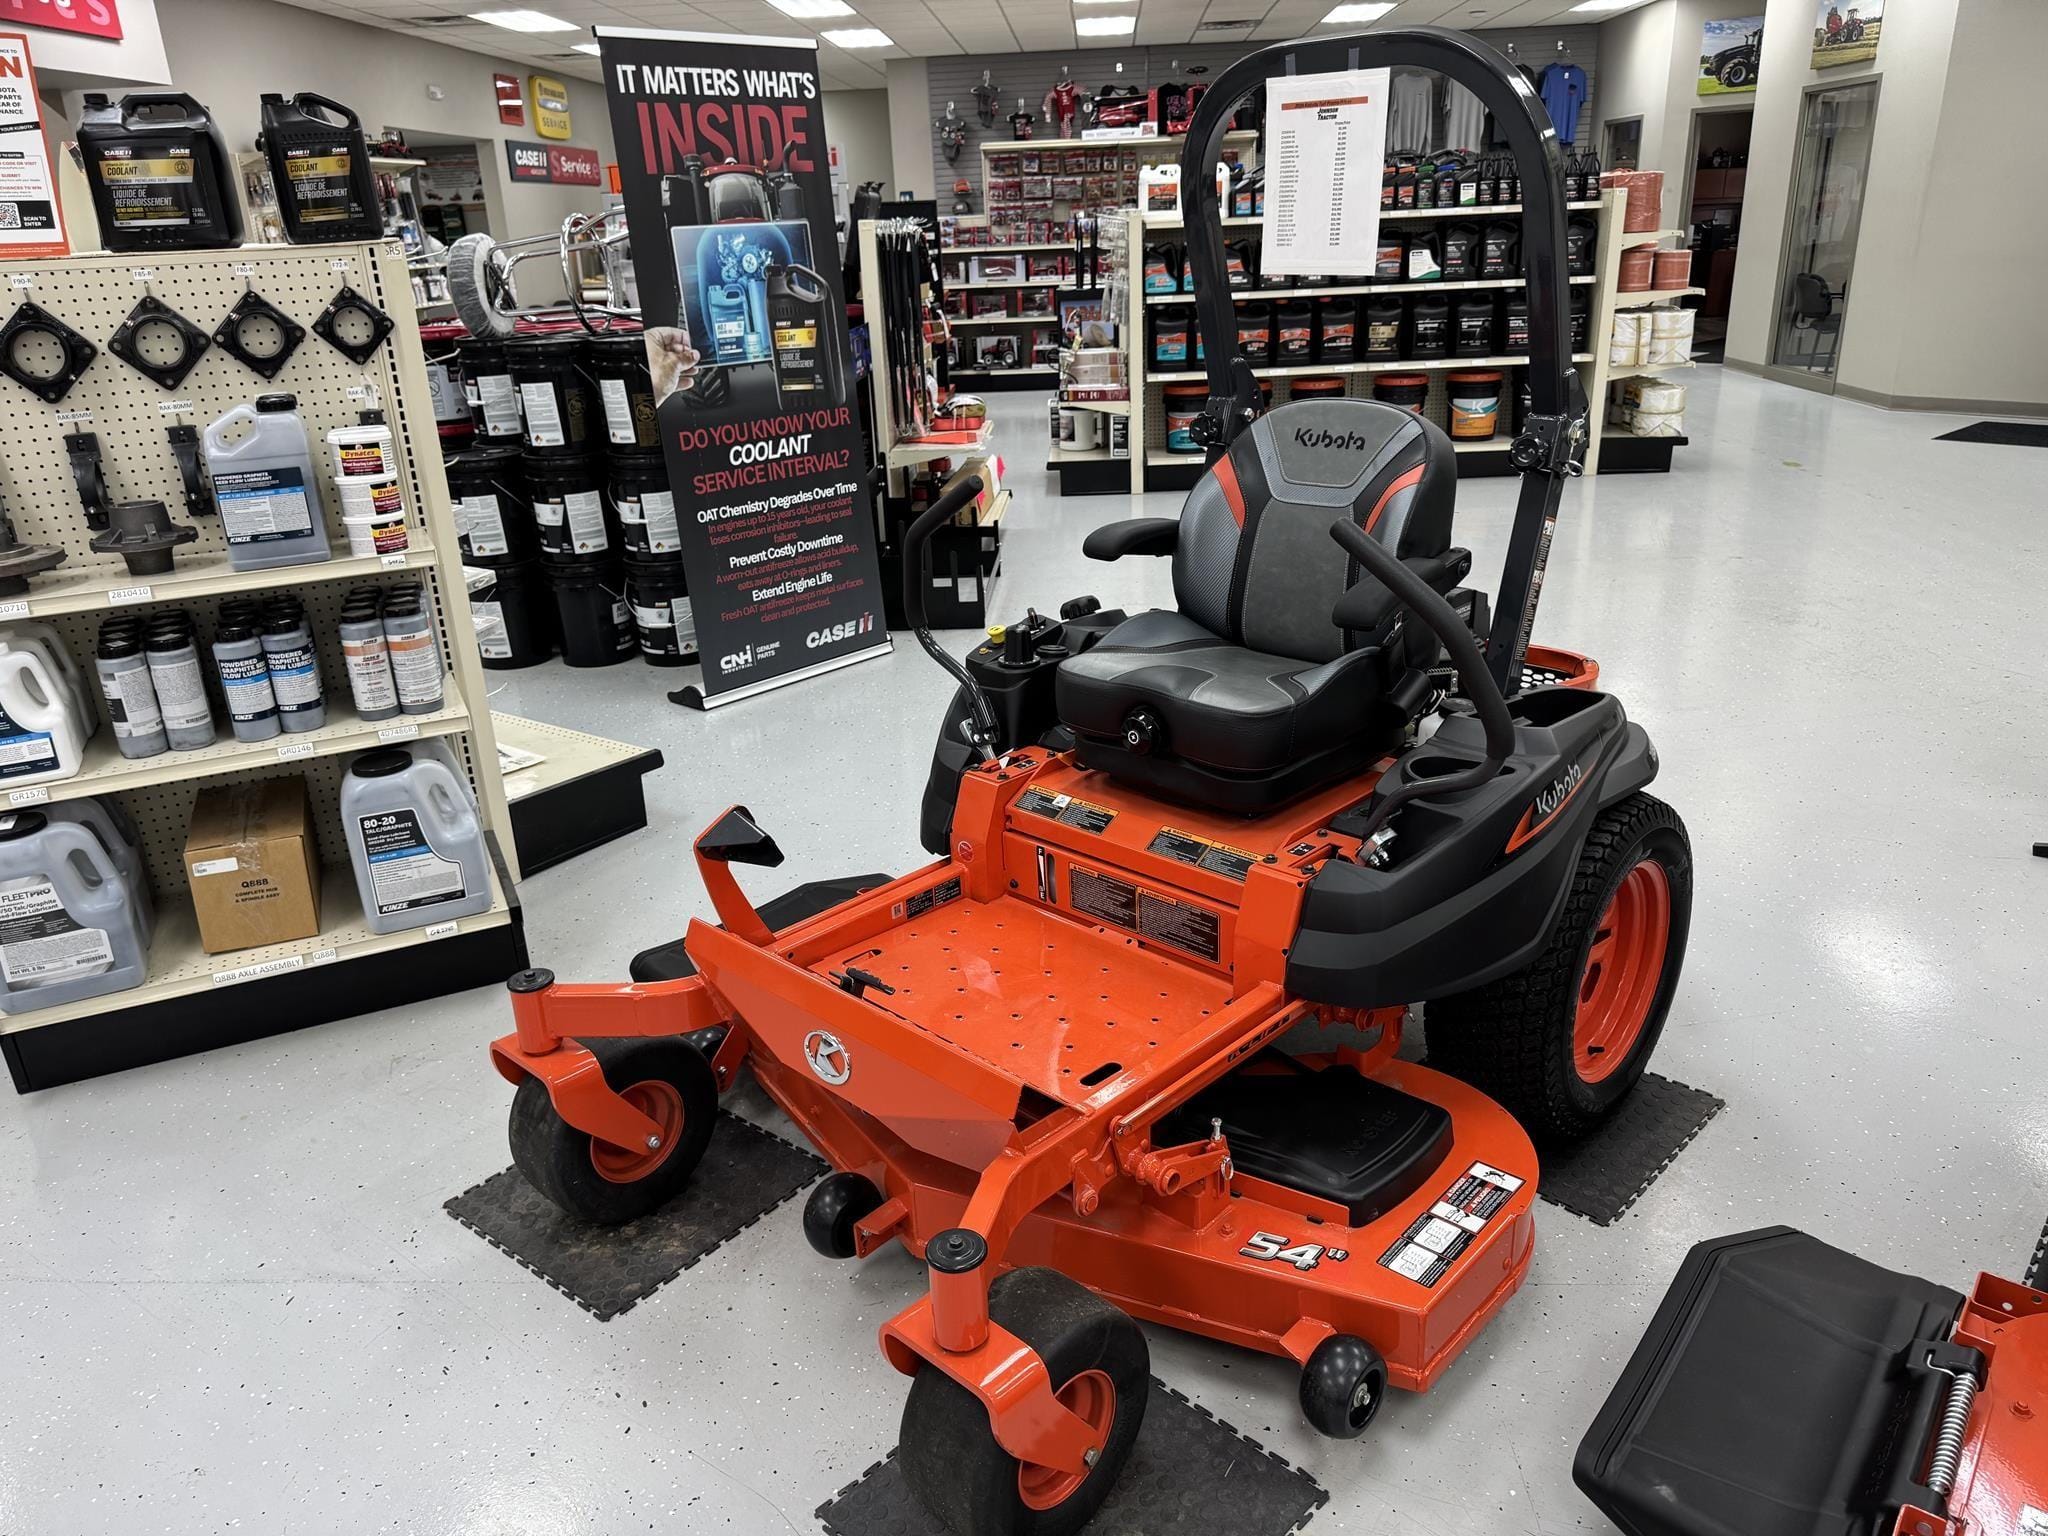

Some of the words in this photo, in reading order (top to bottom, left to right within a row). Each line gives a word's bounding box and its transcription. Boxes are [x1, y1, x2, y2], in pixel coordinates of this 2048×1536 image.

[616, 64, 636, 93] IT
[642, 65, 740, 97] MATTERS
[743, 69, 816, 99] WHAT'S
[543, 117, 567, 130] SERVICE
[636, 102, 814, 175] INSIDE
[290, 163, 318, 172] COOLANT
[515, 149, 539, 166] CASE
[560, 156, 591, 175] Service
[107, 166, 138, 176] COOLANT
[295, 182, 318, 192] LIQUIDE
[318, 181, 326, 190] DE
[113, 189, 136, 199] LIQUIDE
[138, 189, 146, 197] DE
[297, 188, 348, 200] REFROIDISSEMENT
[115, 197, 172, 207] REFROIDISSEMENT
[777, 334, 796, 343] COOLANT
[679, 428, 709, 451] DO
[709, 422, 748, 446] YOU
[751, 413, 804, 438] KNOW
[803, 407, 851, 432] YOUR
[1295, 427, 1365, 450] Kubota
[729, 434, 812, 466] COOLANT
[693, 465, 766, 495] SERVICE
[769, 449, 850, 481] INTERVAL?
[697, 509, 718, 523] OAT
[719, 498, 769, 519] Chemistry
[769, 490, 813, 510] Degrades
[814, 486, 835, 500] Over
[835, 481, 857, 495] Time
[708, 525, 716, 534] In
[716, 519, 747, 533] engines
[747, 517, 757, 527] up
[757, 514, 766, 523] to
[767, 513, 776, 522] 15
[775, 509, 796, 522] years
[796, 504, 809, 516] old,
[809, 502, 826, 515] your
[827, 496, 853, 509] coolant
[710, 534, 735, 546] loses
[733, 527, 767, 542] corrosion
[831, 511, 839, 519] to
[839, 507, 853, 517] seal
[230, 536, 252, 544] KINZE
[774, 532, 799, 544] failure.
[729, 550, 767, 569] Prevent
[767, 543, 798, 560] Costly
[797, 533, 844, 553] Downtime
[716, 575, 723, 585] A
[722, 568, 759, 583] worn-out
[758, 559, 794, 575] antifreeze
[794, 554, 817, 565] allows
[817, 550, 833, 560] acid
[832, 543, 859, 558] buildup,
[738, 581, 754, 592] eats
[754, 576, 773, 589] away
[773, 573, 782, 582] at
[782, 567, 808, 582] O-rings
[808, 563, 822, 573] and
[822, 558, 843, 569] liners.
[752, 584, 786, 602] Extend
[786, 577, 817, 593] Engine
[817, 571, 833, 585] Life
[111, 588, 149, 599] 2810410
[721, 609, 743, 622] Fresh
[743, 605, 759, 617] OAT
[760, 595, 795, 612] antifreeze
[795, 591, 816, 603] keeps
[816, 585, 835, 596] metal
[835, 578, 864, 593] surfaces
[761, 612, 781, 623] clean
[781, 606, 796, 618] and
[796, 599, 832, 616] protected.
[806, 620, 856, 648] CASE
[756, 641, 780, 653] GENUINE
[267, 651, 302, 659] POWDERED
[268, 656, 300, 665] GRAPHITE
[221, 658, 258, 667] POWDERED
[222, 664, 255, 674] GRAPHITE
[722, 663, 753, 675] INDUSTRIAL
[757, 650, 775, 661] PARTS
[11, 790, 47, 801] GR1570
[1535, 764, 1581, 814] Kubota
[363, 816, 396, 829] 80-20
[366, 822, 412, 834] TALC/GRAPHITE
[1038, 848, 1043, 856] F
[1227, 846, 1258, 859] ADVERTENCIA
[241, 878, 268, 889] Q888
[2, 887, 51, 903] FLEETPRO
[235, 889, 264, 898] COMPLETE
[1041, 892, 1045, 900] E
[13, 899, 56, 911] Talc/Graphite
[28, 904, 58, 914] Lubricant
[382, 902, 410, 913] KINZE
[314, 949, 335, 960] Q888
[215, 972, 237, 983] Q888
[238, 967, 258, 978] AXLE
[260, 959, 301, 974] ASSEMBLY
[1449, 1177, 1467, 1194] DANGER
[1239, 1231, 1350, 1271] 54"
